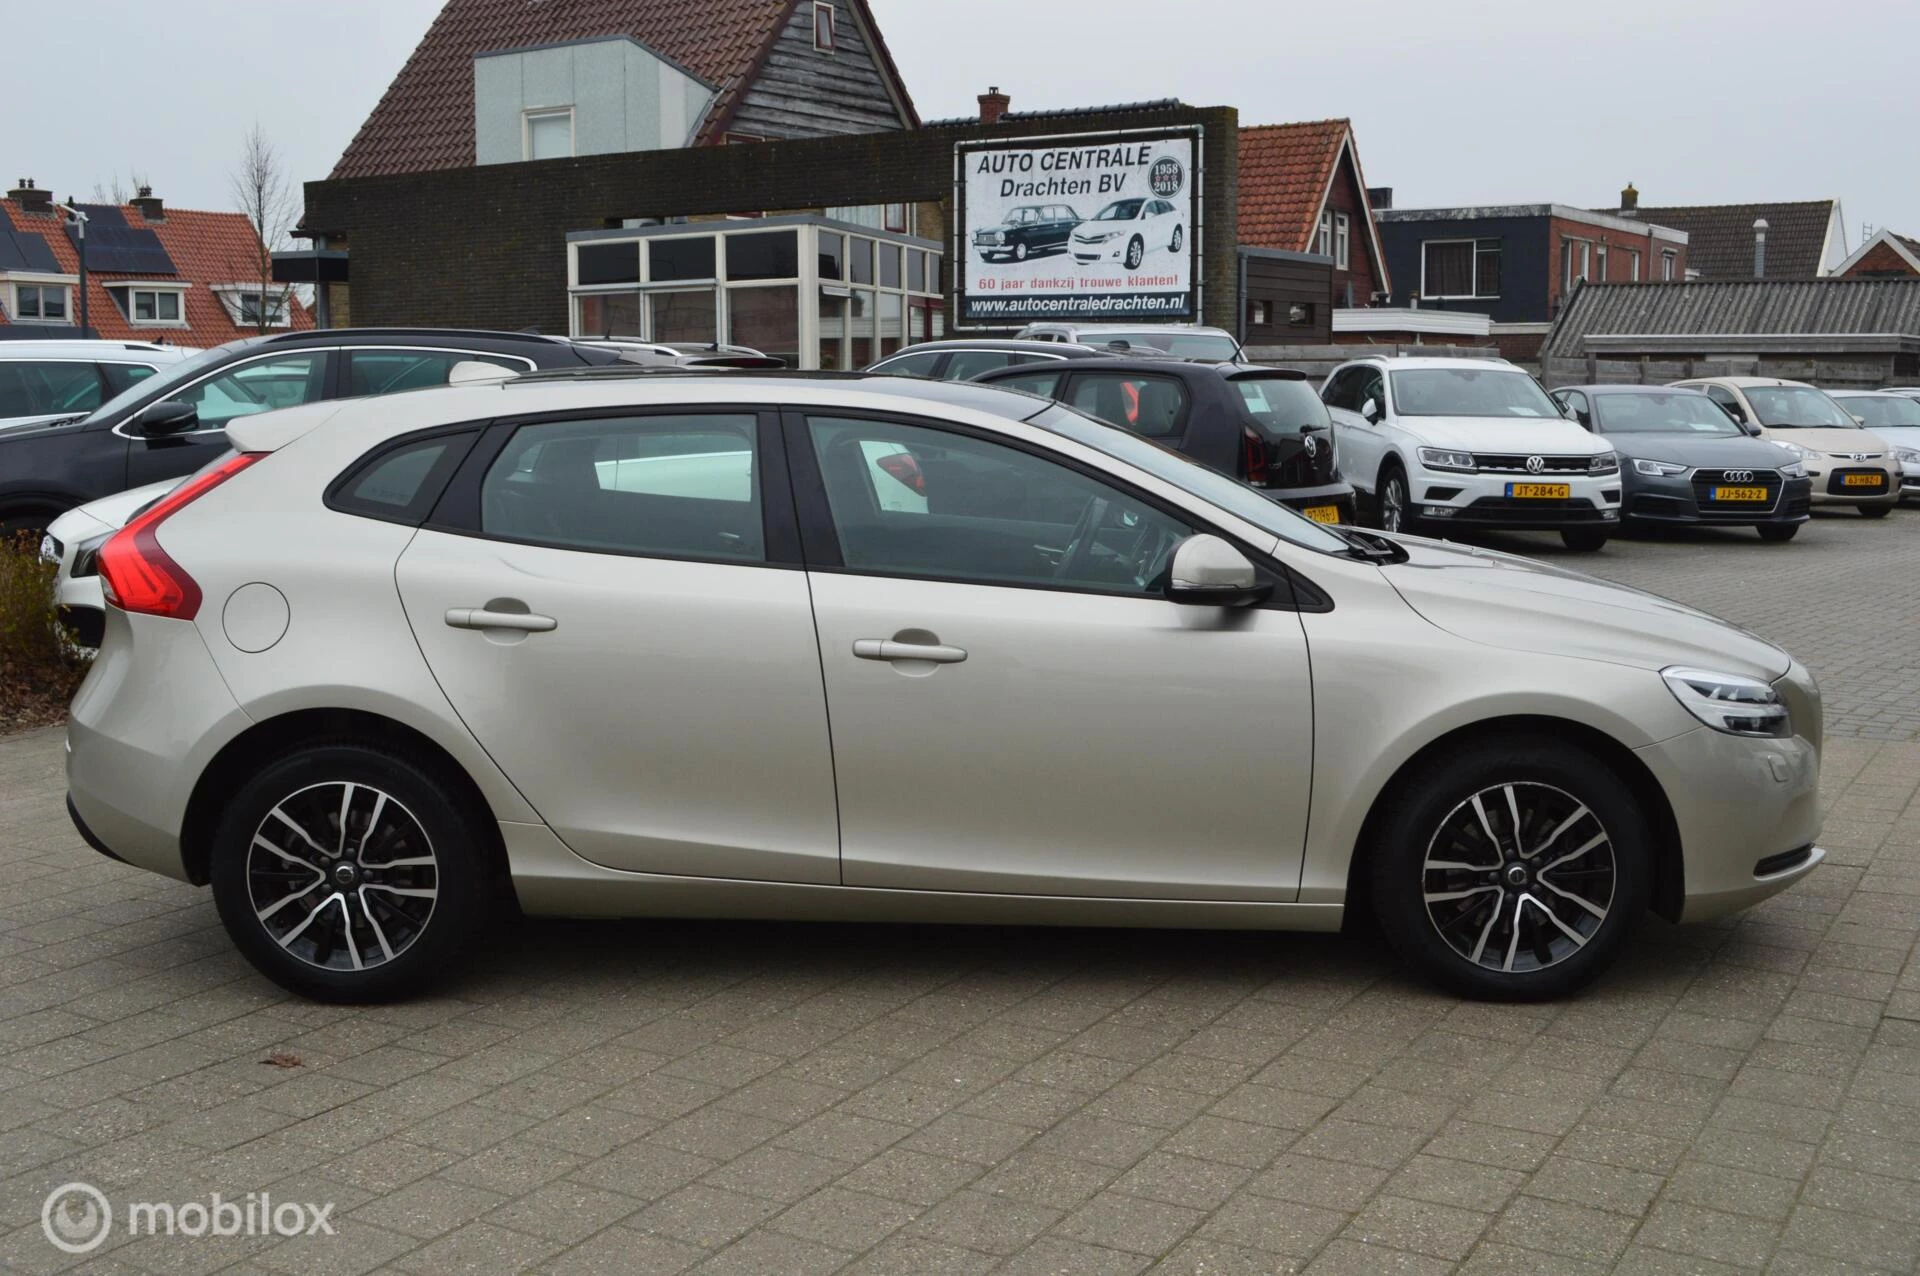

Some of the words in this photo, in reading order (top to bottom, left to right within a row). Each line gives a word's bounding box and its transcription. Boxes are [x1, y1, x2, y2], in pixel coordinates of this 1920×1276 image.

[977, 153, 1034, 174] AUTO
[1040, 146, 1152, 170] CENTRALE
[1154, 163, 1179, 175] 1958
[1000, 175, 1091, 198] Drachten
[1098, 173, 1127, 193] BV
[1154, 181, 1179, 192] 2018
[978, 278, 995, 290] 60
[1001, 278, 1025, 291] jaar
[1030, 276, 1075, 290] dankzij
[1080, 276, 1122, 288] trouwe
[1128, 274, 1178, 286] klanten!
[971, 294, 1185, 312] www.autocentraledrachten.nl
[1515, 485, 1565, 497] JT-284-G
[1720, 489, 1763, 499] JJ-562-Z
